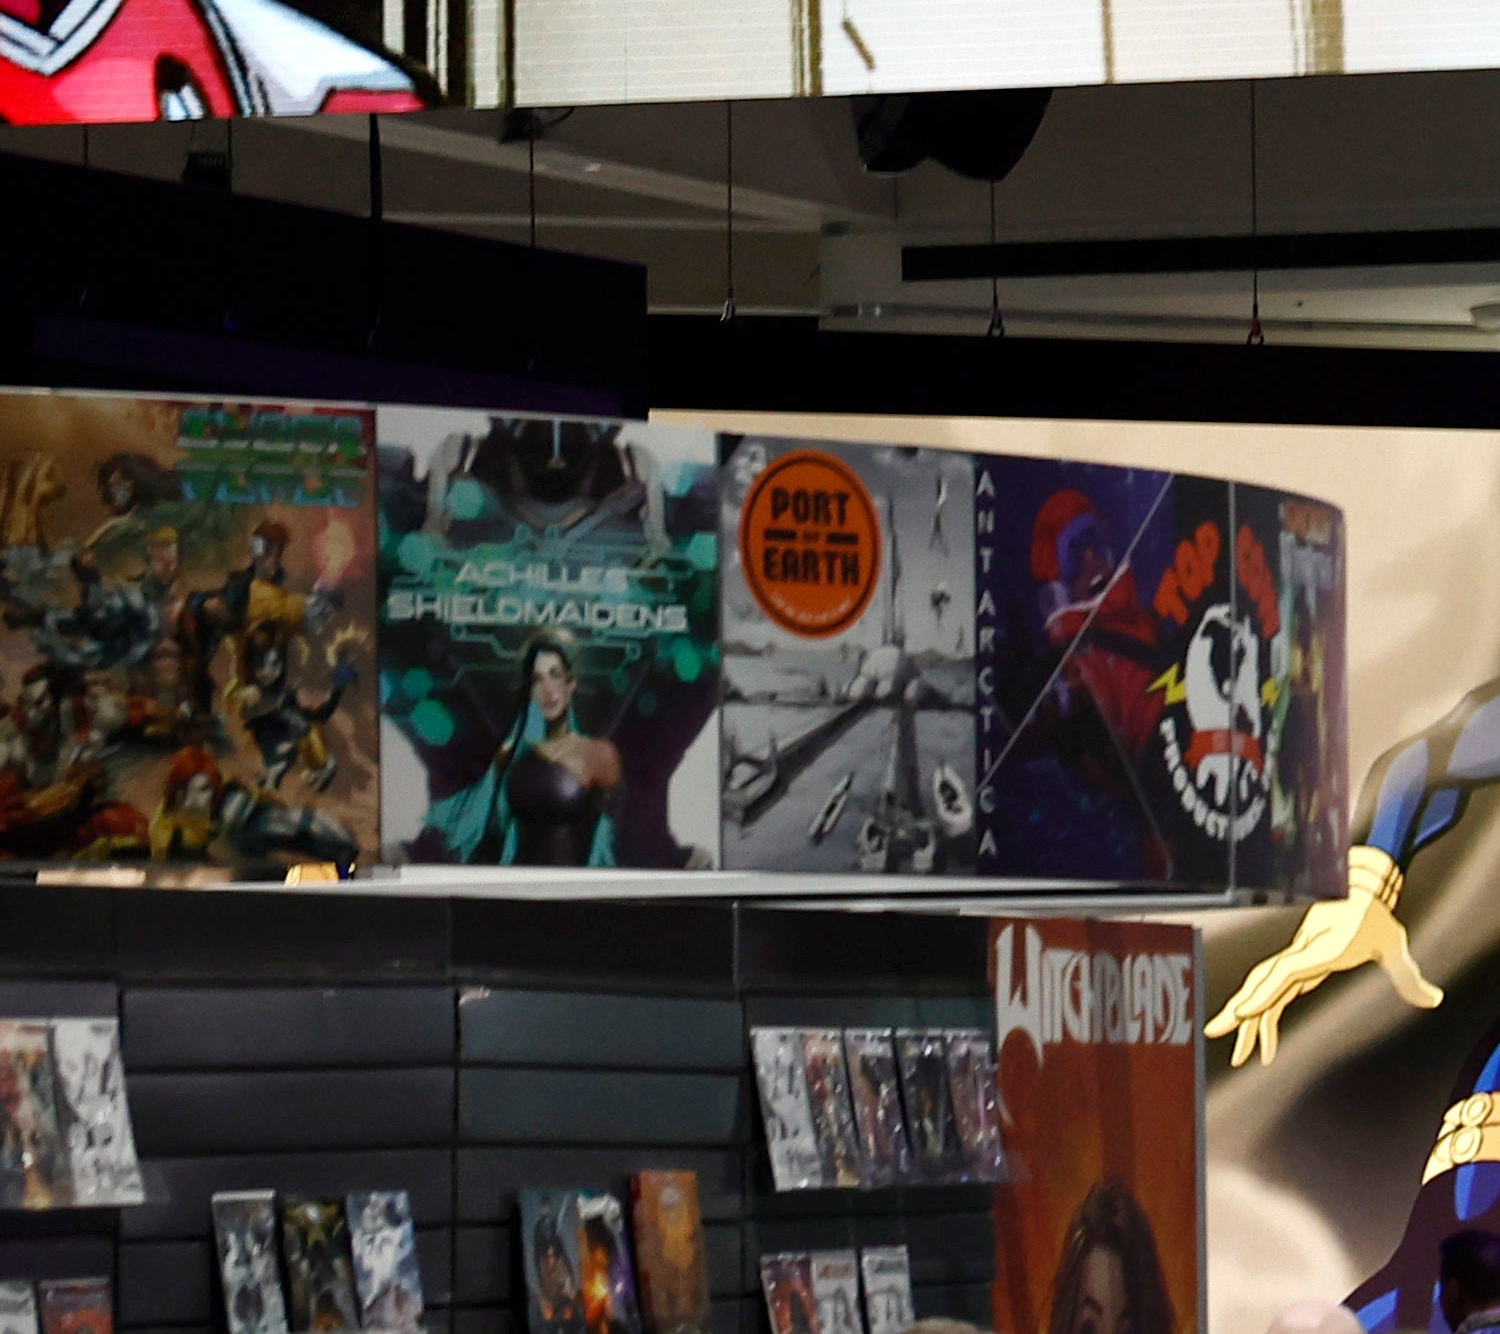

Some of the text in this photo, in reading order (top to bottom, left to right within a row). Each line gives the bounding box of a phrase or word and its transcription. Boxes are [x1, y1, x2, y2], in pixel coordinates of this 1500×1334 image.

[771, 487, 850, 526] PORT
[763, 547, 860, 587] EARTH
[384, 589, 690, 634] SHIELDMAIDENS
[975, 470, 998, 858] ANTARCTICA
[994, 922, 1194, 1065] WITCHBLADE
